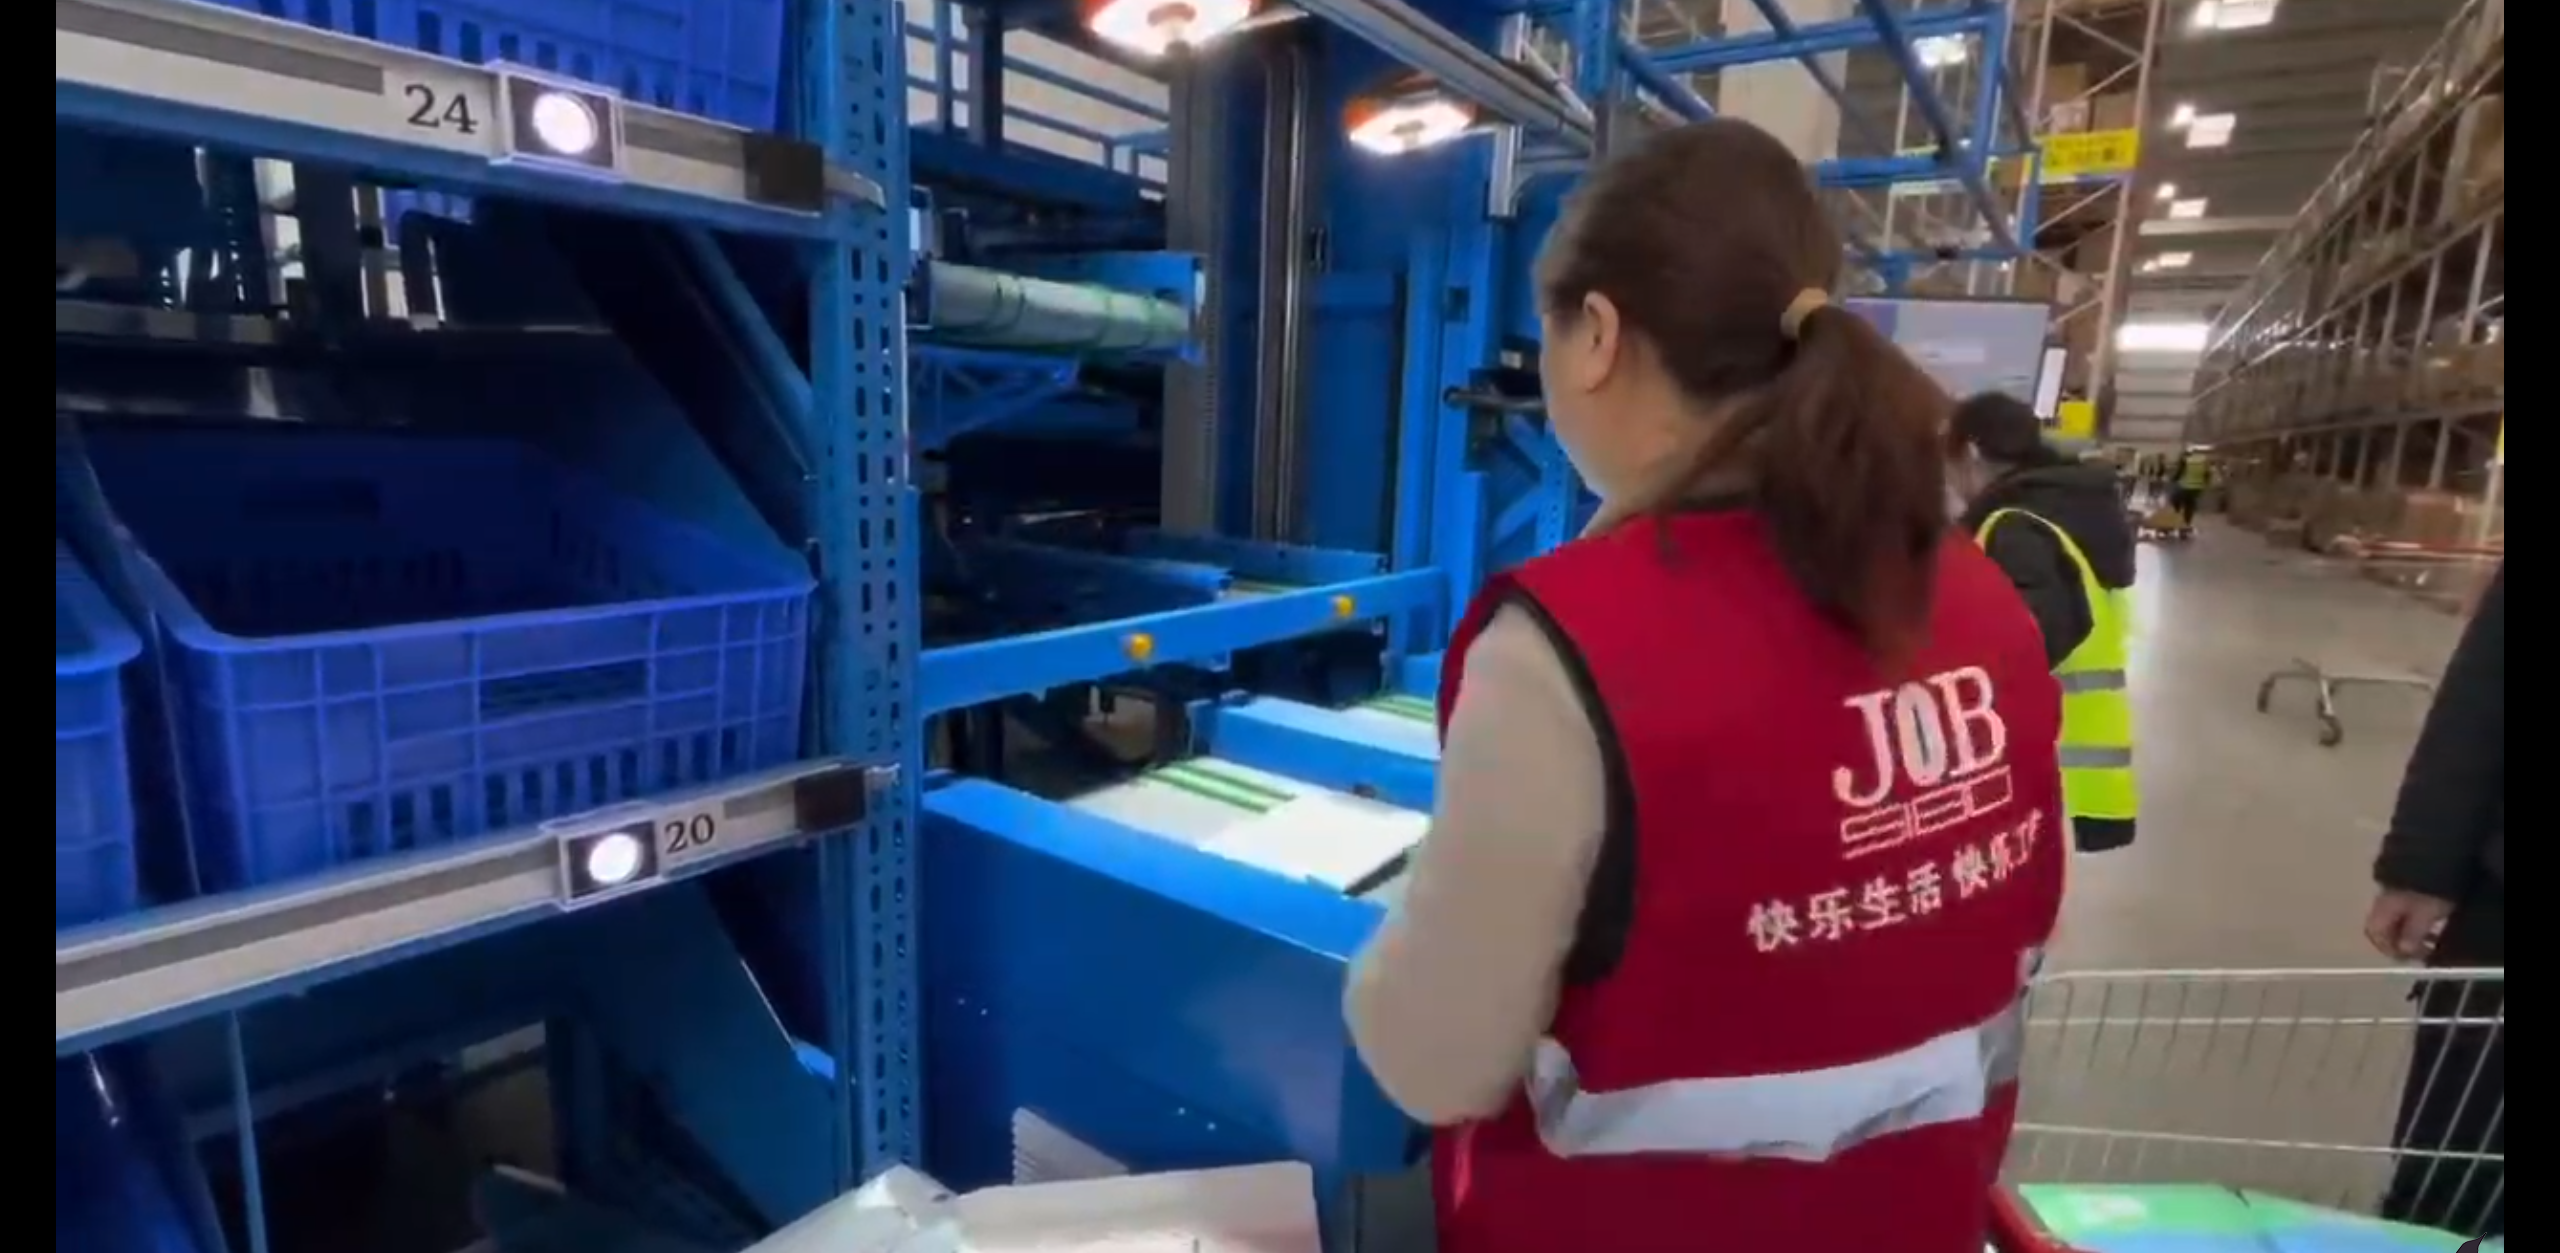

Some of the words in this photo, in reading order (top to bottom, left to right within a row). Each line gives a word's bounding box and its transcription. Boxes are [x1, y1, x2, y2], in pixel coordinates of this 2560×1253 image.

[404, 84, 478, 135] 24
[1833, 666, 2006, 806] JOB
[664, 813, 715, 854] 20
[1747, 861, 1942, 952] 快乐生活
